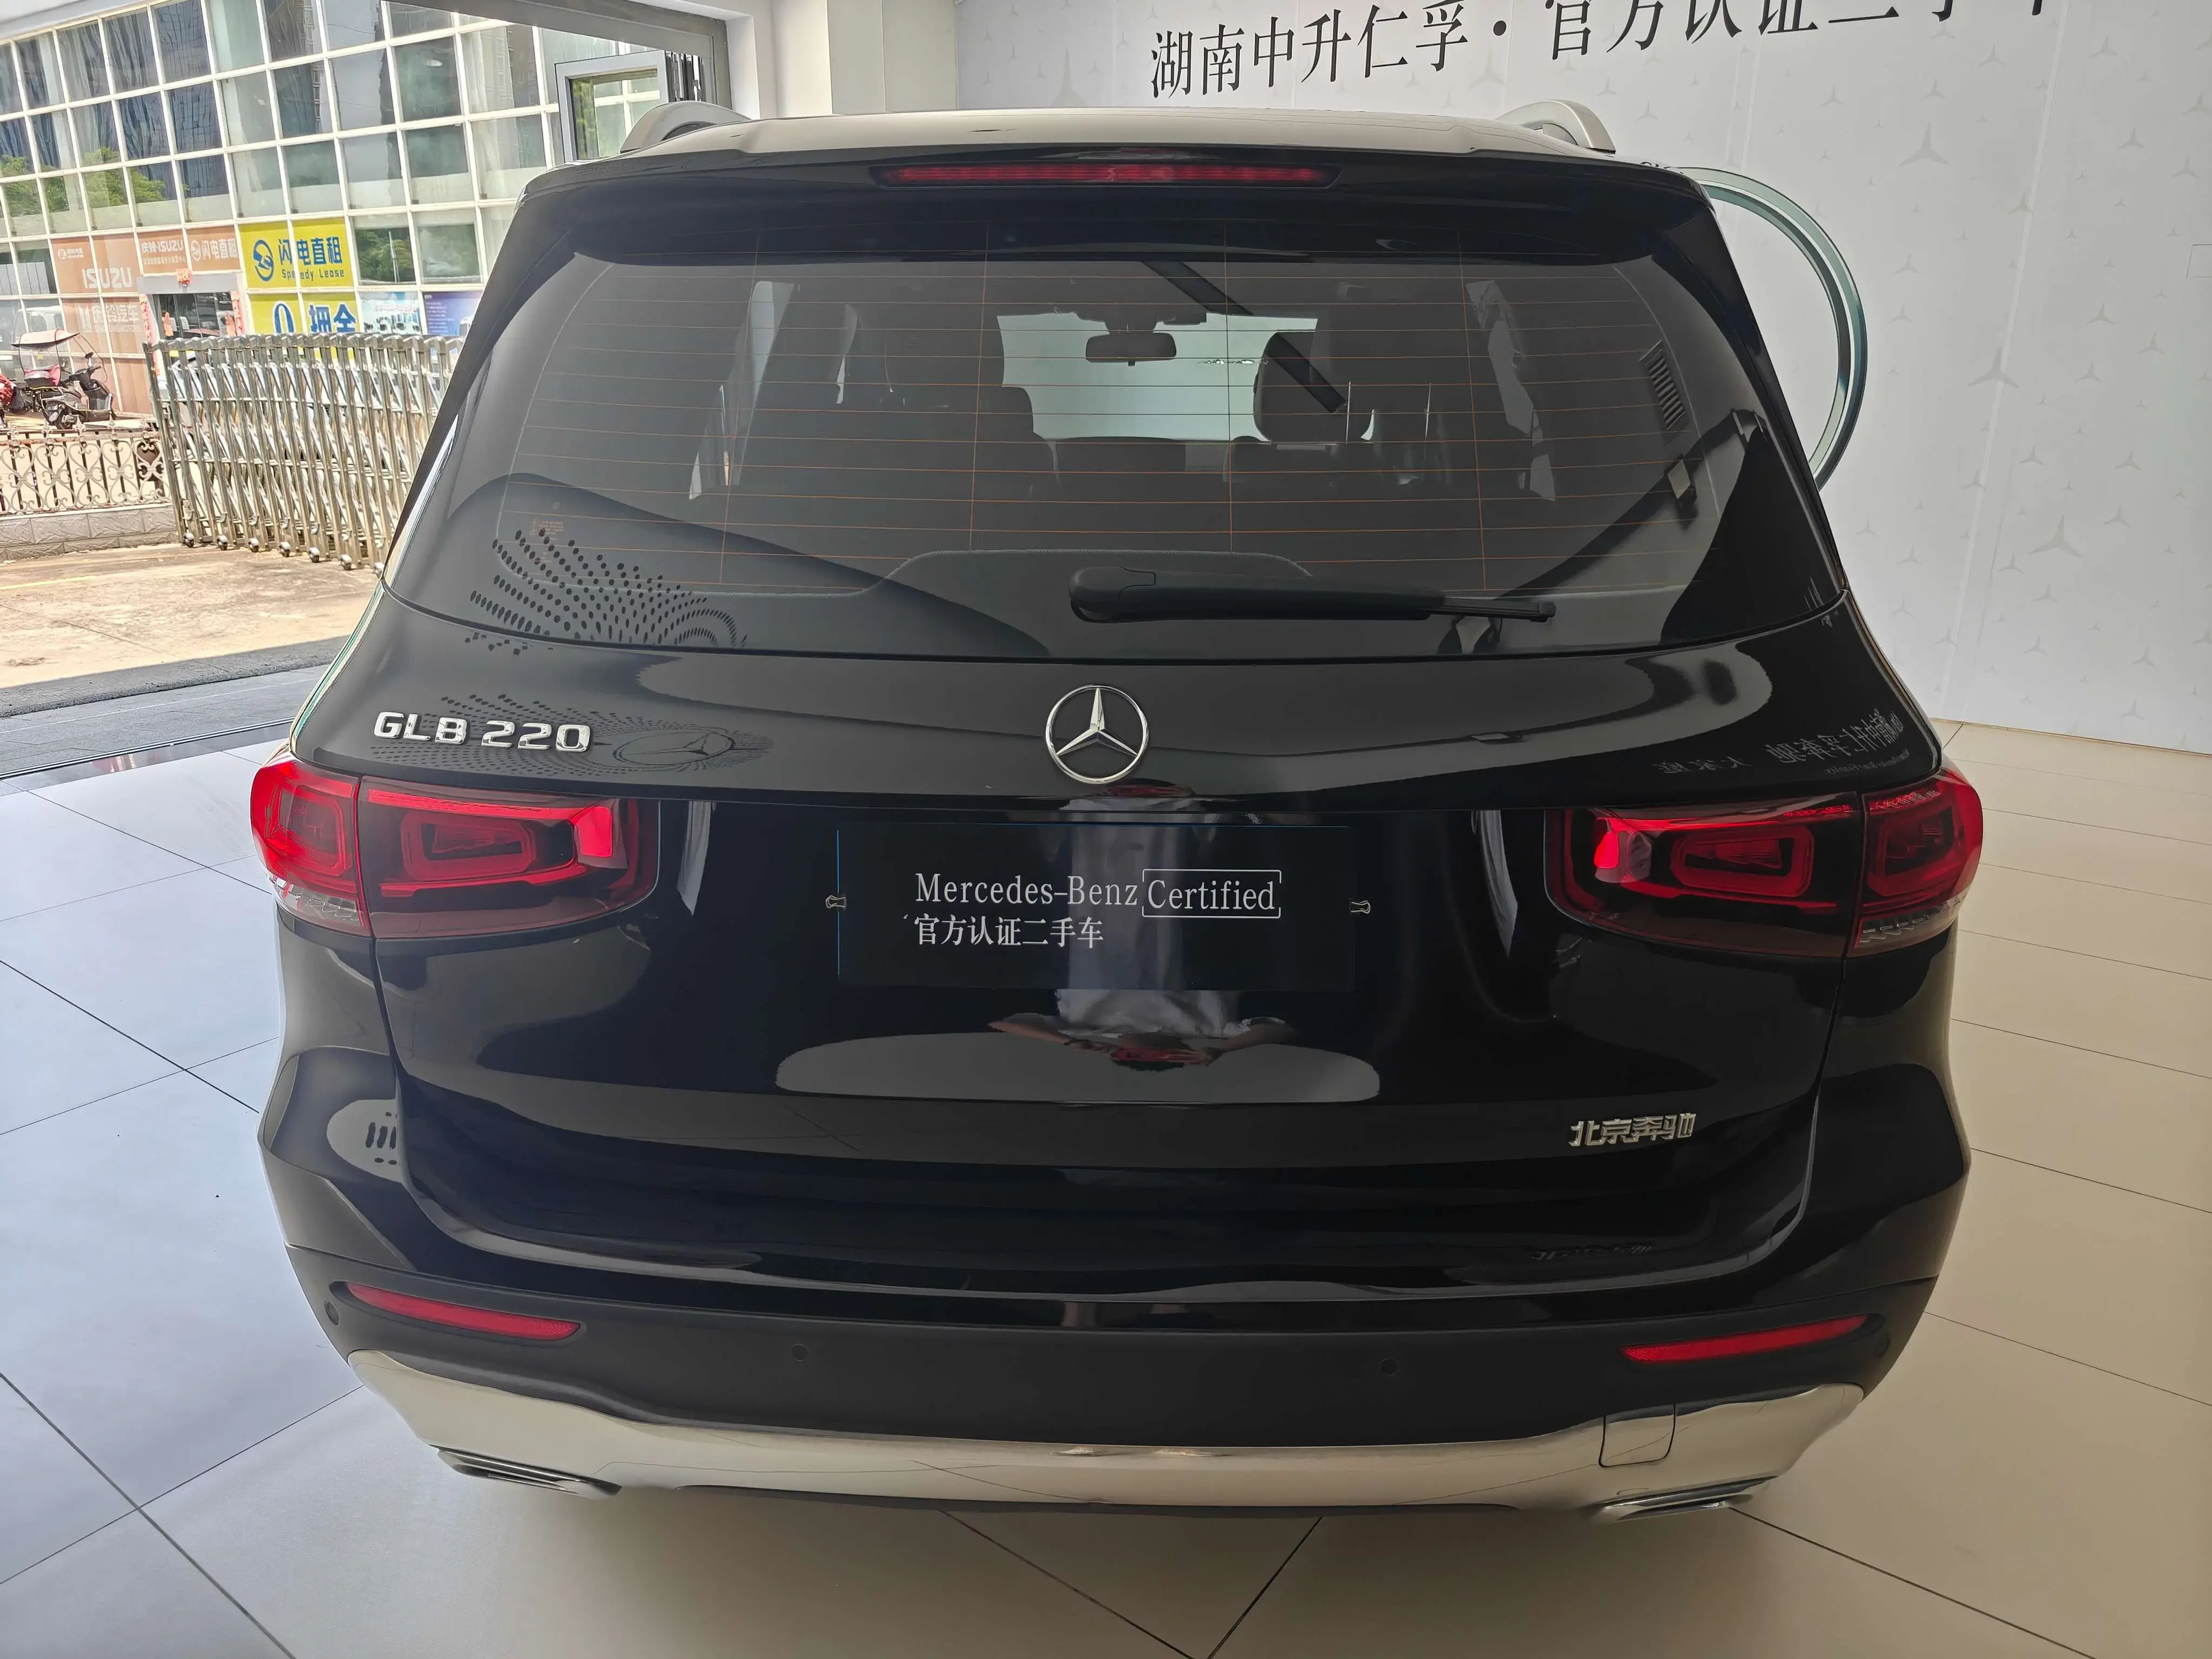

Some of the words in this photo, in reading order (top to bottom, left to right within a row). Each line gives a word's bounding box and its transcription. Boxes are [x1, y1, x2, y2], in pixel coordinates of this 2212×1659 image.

[201, 238, 238, 260] 闪电直租
[278, 237, 342, 266] 闪电直租
[82, 267, 133, 288] ISUZU
[282, 269, 314, 281] Speedy
[319, 268, 345, 278] Lease
[374, 711, 468, 744] GLB
[481, 720, 592, 752] 220
[915, 873, 1138, 906] Mercedes-Benz
[1148, 880, 1275, 910] Certified
[914, 913, 1103, 948] 官方认证二手车
[1568, 1112, 1697, 1147] 北京奔驰
